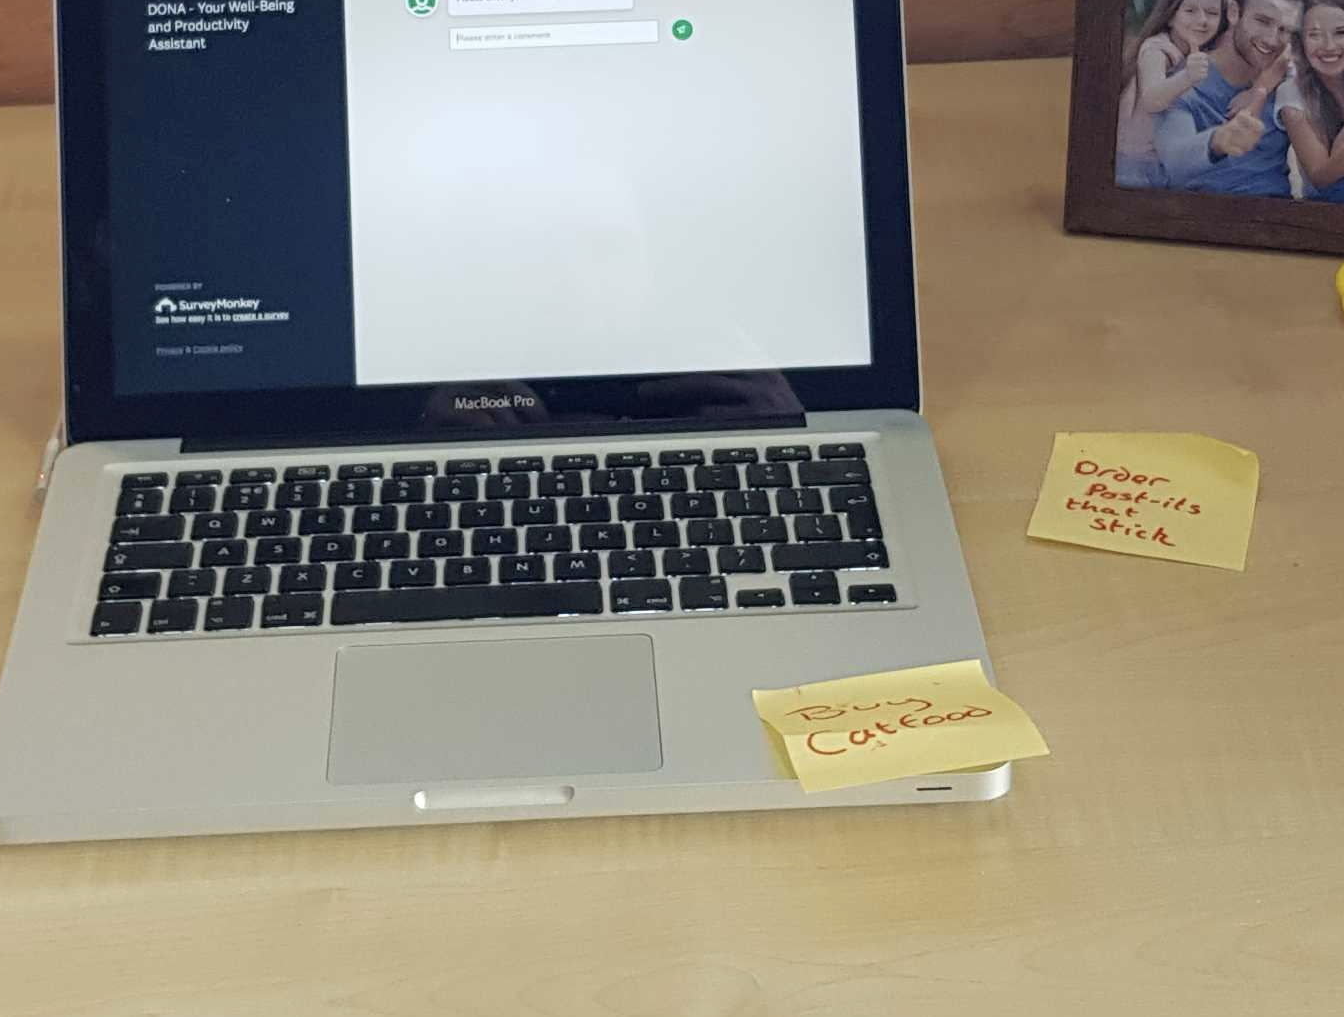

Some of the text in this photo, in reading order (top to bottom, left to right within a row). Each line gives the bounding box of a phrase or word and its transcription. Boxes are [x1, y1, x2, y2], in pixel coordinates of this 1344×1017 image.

[147, 2, 186, 16] DONA
[197, 0, 225, 15] Your
[148, 18, 250, 33] and Productivity
[148, 37, 207, 50] Assistant
[178, 298, 260, 311] SurveyMonkey
[454, 394, 535, 409] MacBook Pro
[1074, 460, 1171, 487] Order
[1065, 498, 1140, 518] that
